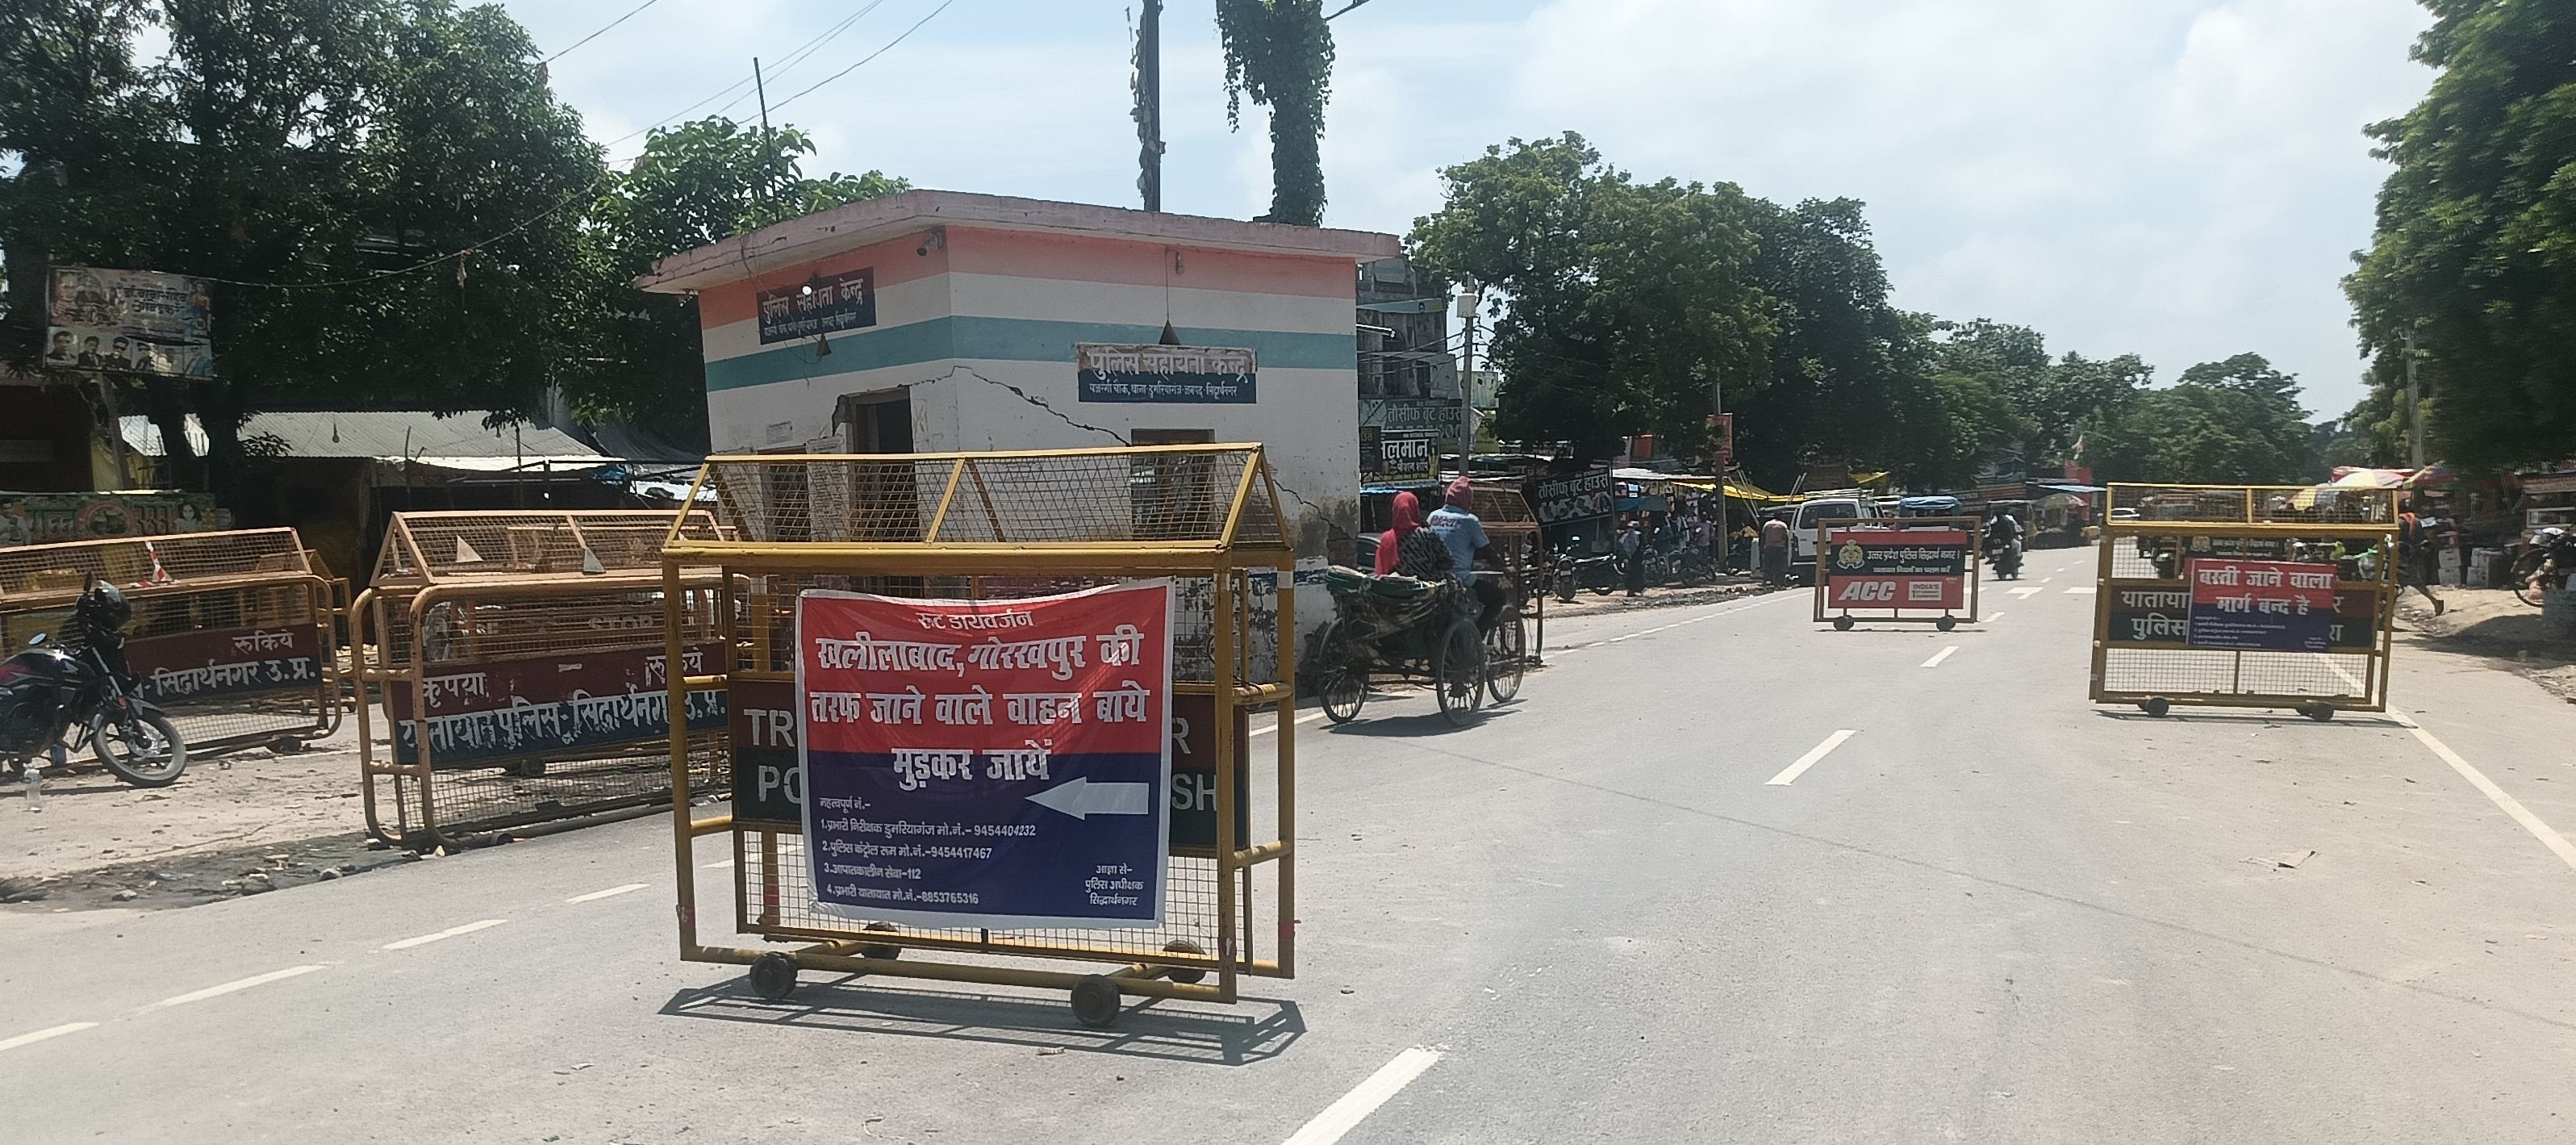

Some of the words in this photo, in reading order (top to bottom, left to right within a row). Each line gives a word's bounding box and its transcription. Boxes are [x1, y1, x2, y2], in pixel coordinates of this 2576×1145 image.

[1087, 347, 1140, 380] पुलिस
[1142, 352, 1204, 381] सहायता
[1584, 473, 1609, 491] हाउस
[2198, 566, 2241, 586] बस्ती
[2244, 566, 2284, 587] जाने
[2289, 571, 2333, 589] वाला
[1838, 581, 1897, 601] ACC
[2121, 591, 2190, 608] याताया
[2215, 592, 2252, 613] मार्ग
[2257, 597, 2291, 615] बन्द
[2296, 594, 2311, 616] है
[946, 608, 1033, 630] डायवर्जन
[2131, 612, 2188, 640] पुलिस
[1096, 624, 1144, 667] की
[423, 672, 486, 708] कृपया
[809, 692, 861, 723] तरफ
[866, 685, 925, 725] जाने
[934, 684, 993, 725] वाले
[1003, 692, 1082, 725] वाहन
[1092, 679, 1150, 722] बाये
[399, 708, 496, 753] यतायात
[891, 747, 974, 792] मुड़कर
[982, 738, 1052, 780] जायें
[850, 817, 883, 833] निरीक्षक
[883, 820, 935, 838] डुमरियागंज
[974, 825, 1036, 837] 9454404232
[858, 888, 891, 900] यातायात
[1085, 876, 1108, 893] पुलिस
[1109, 877, 1144, 890] अधीक्षक
